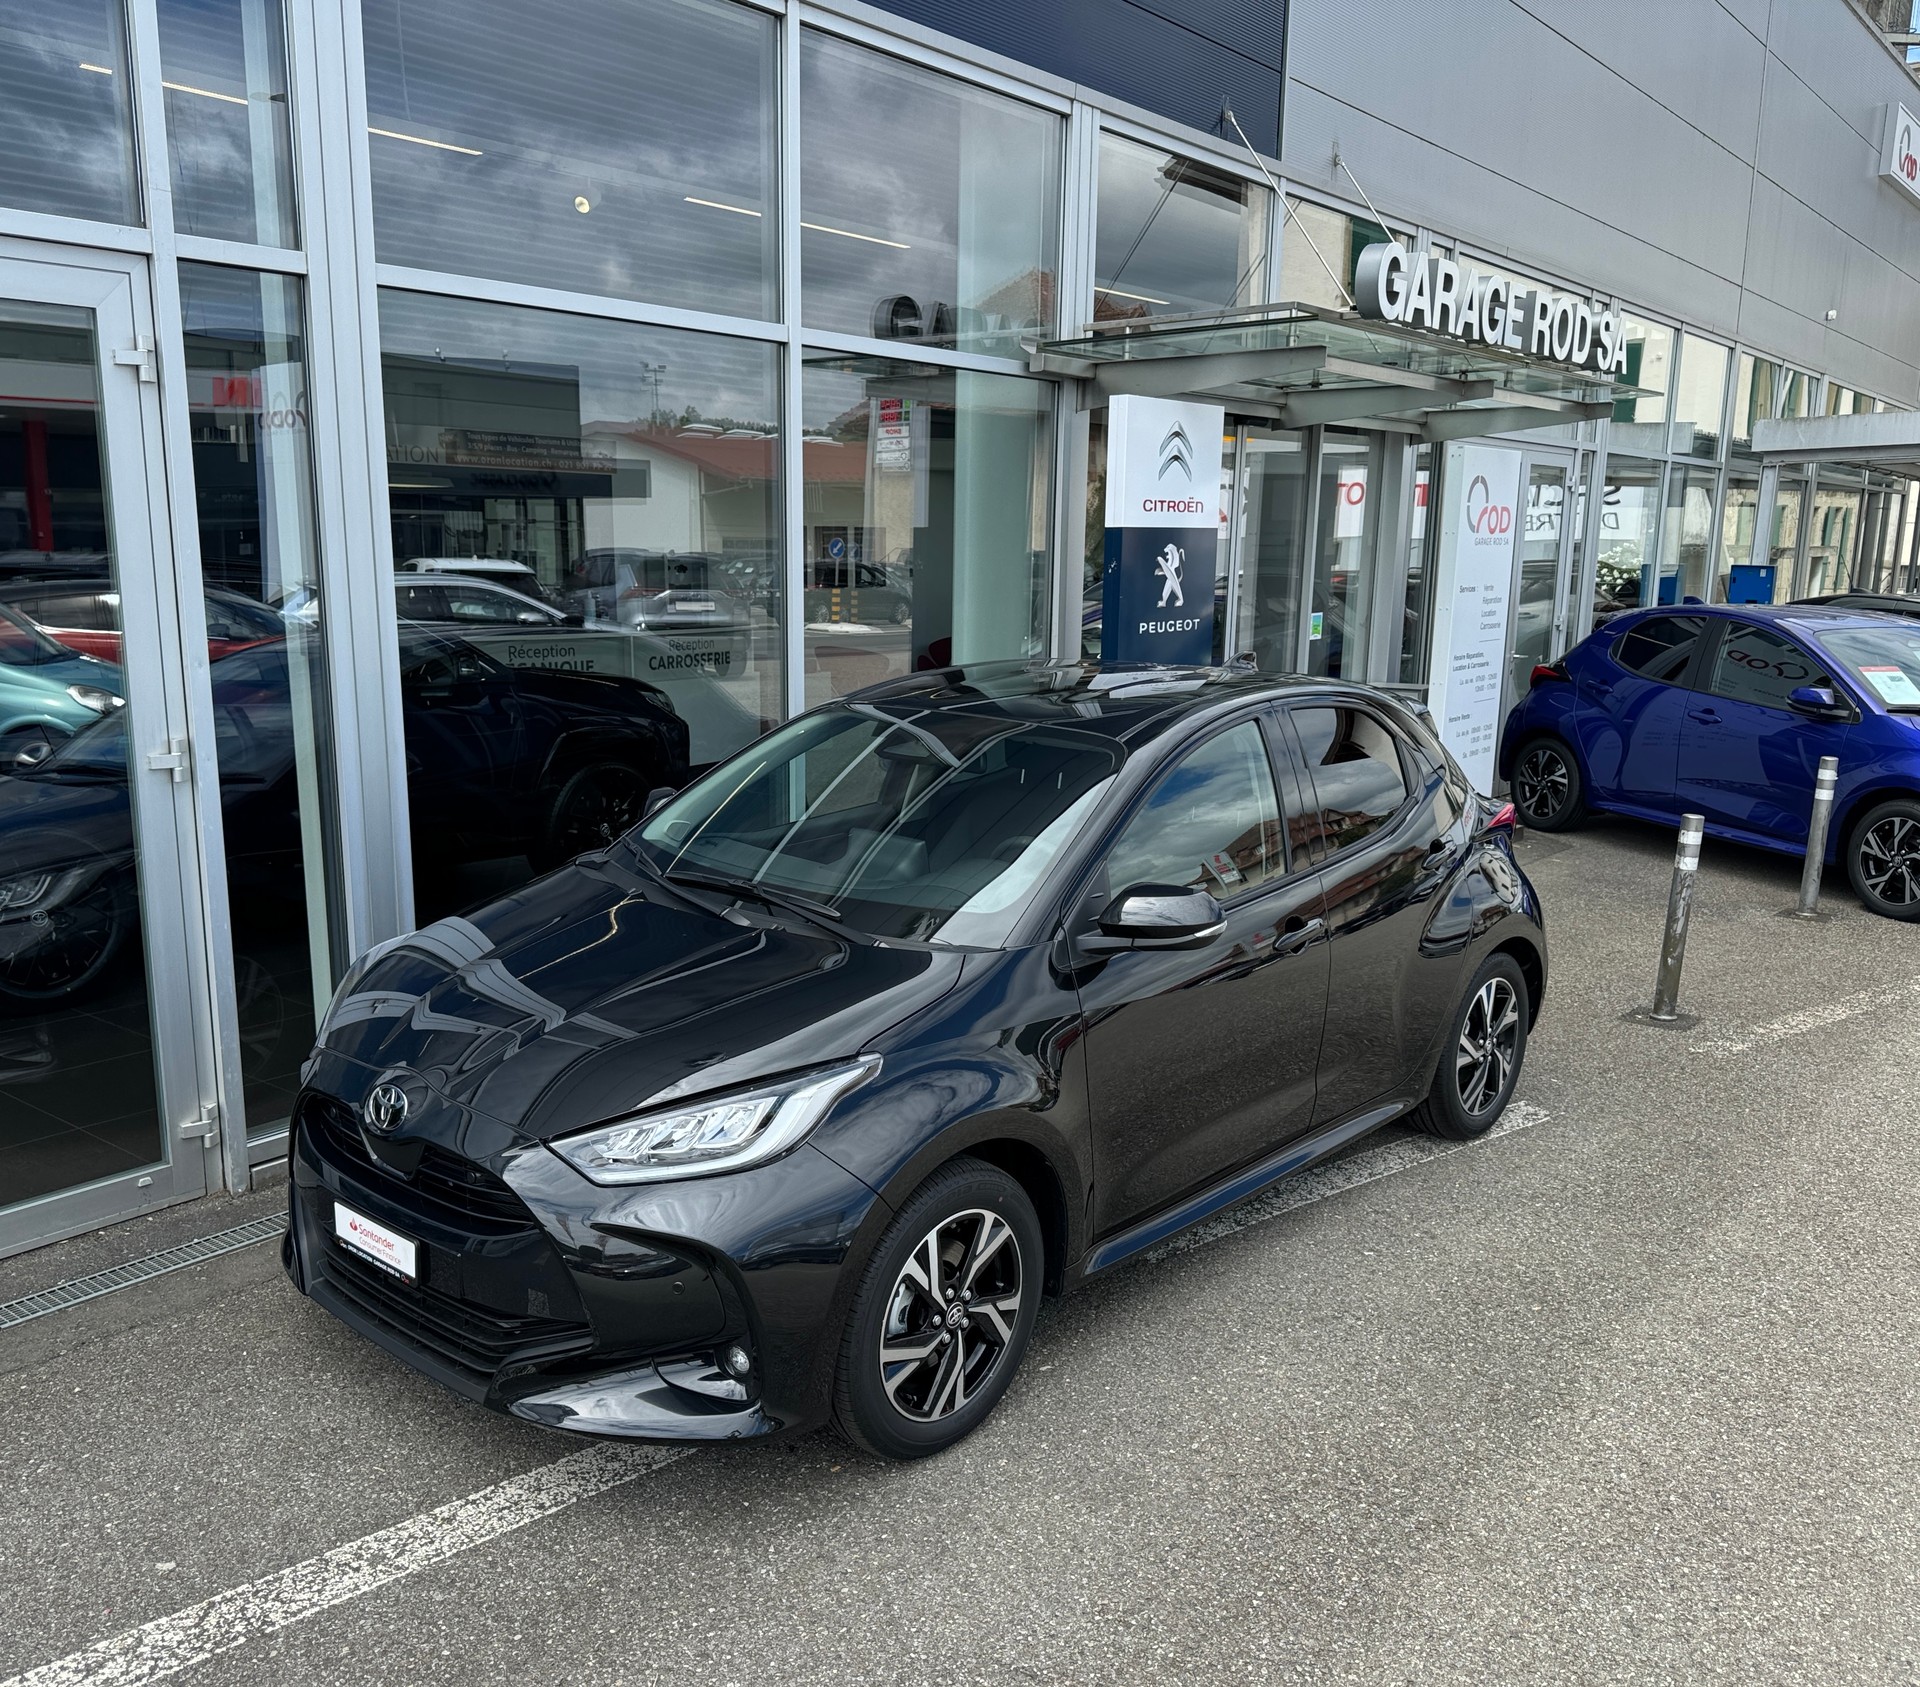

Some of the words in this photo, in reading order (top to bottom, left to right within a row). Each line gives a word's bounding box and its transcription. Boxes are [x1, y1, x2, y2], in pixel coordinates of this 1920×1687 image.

[1377, 241, 1529, 351] GARAGE
[1530, 290, 1592, 365] ROD
[1596, 310, 1627, 375] SA
[1143, 497, 1204, 514] CITROËN
[1474, 537, 1493, 547] GARAGE
[1493, 537, 1503, 547] ROD
[1503, 537, 1510, 547] SA
[1459, 585, 1476, 594] Services
[1139, 618, 1200, 634] PEUGEOT
[508, 644, 576, 661] Réception
[669, 638, 715, 652] Réception
[649, 650, 731, 671] CARROSSERIE
[358, 1223, 395, 1251] Santander
[359, 1236, 383, 1255] Consumer
[382, 1249, 402, 1267] Finance
